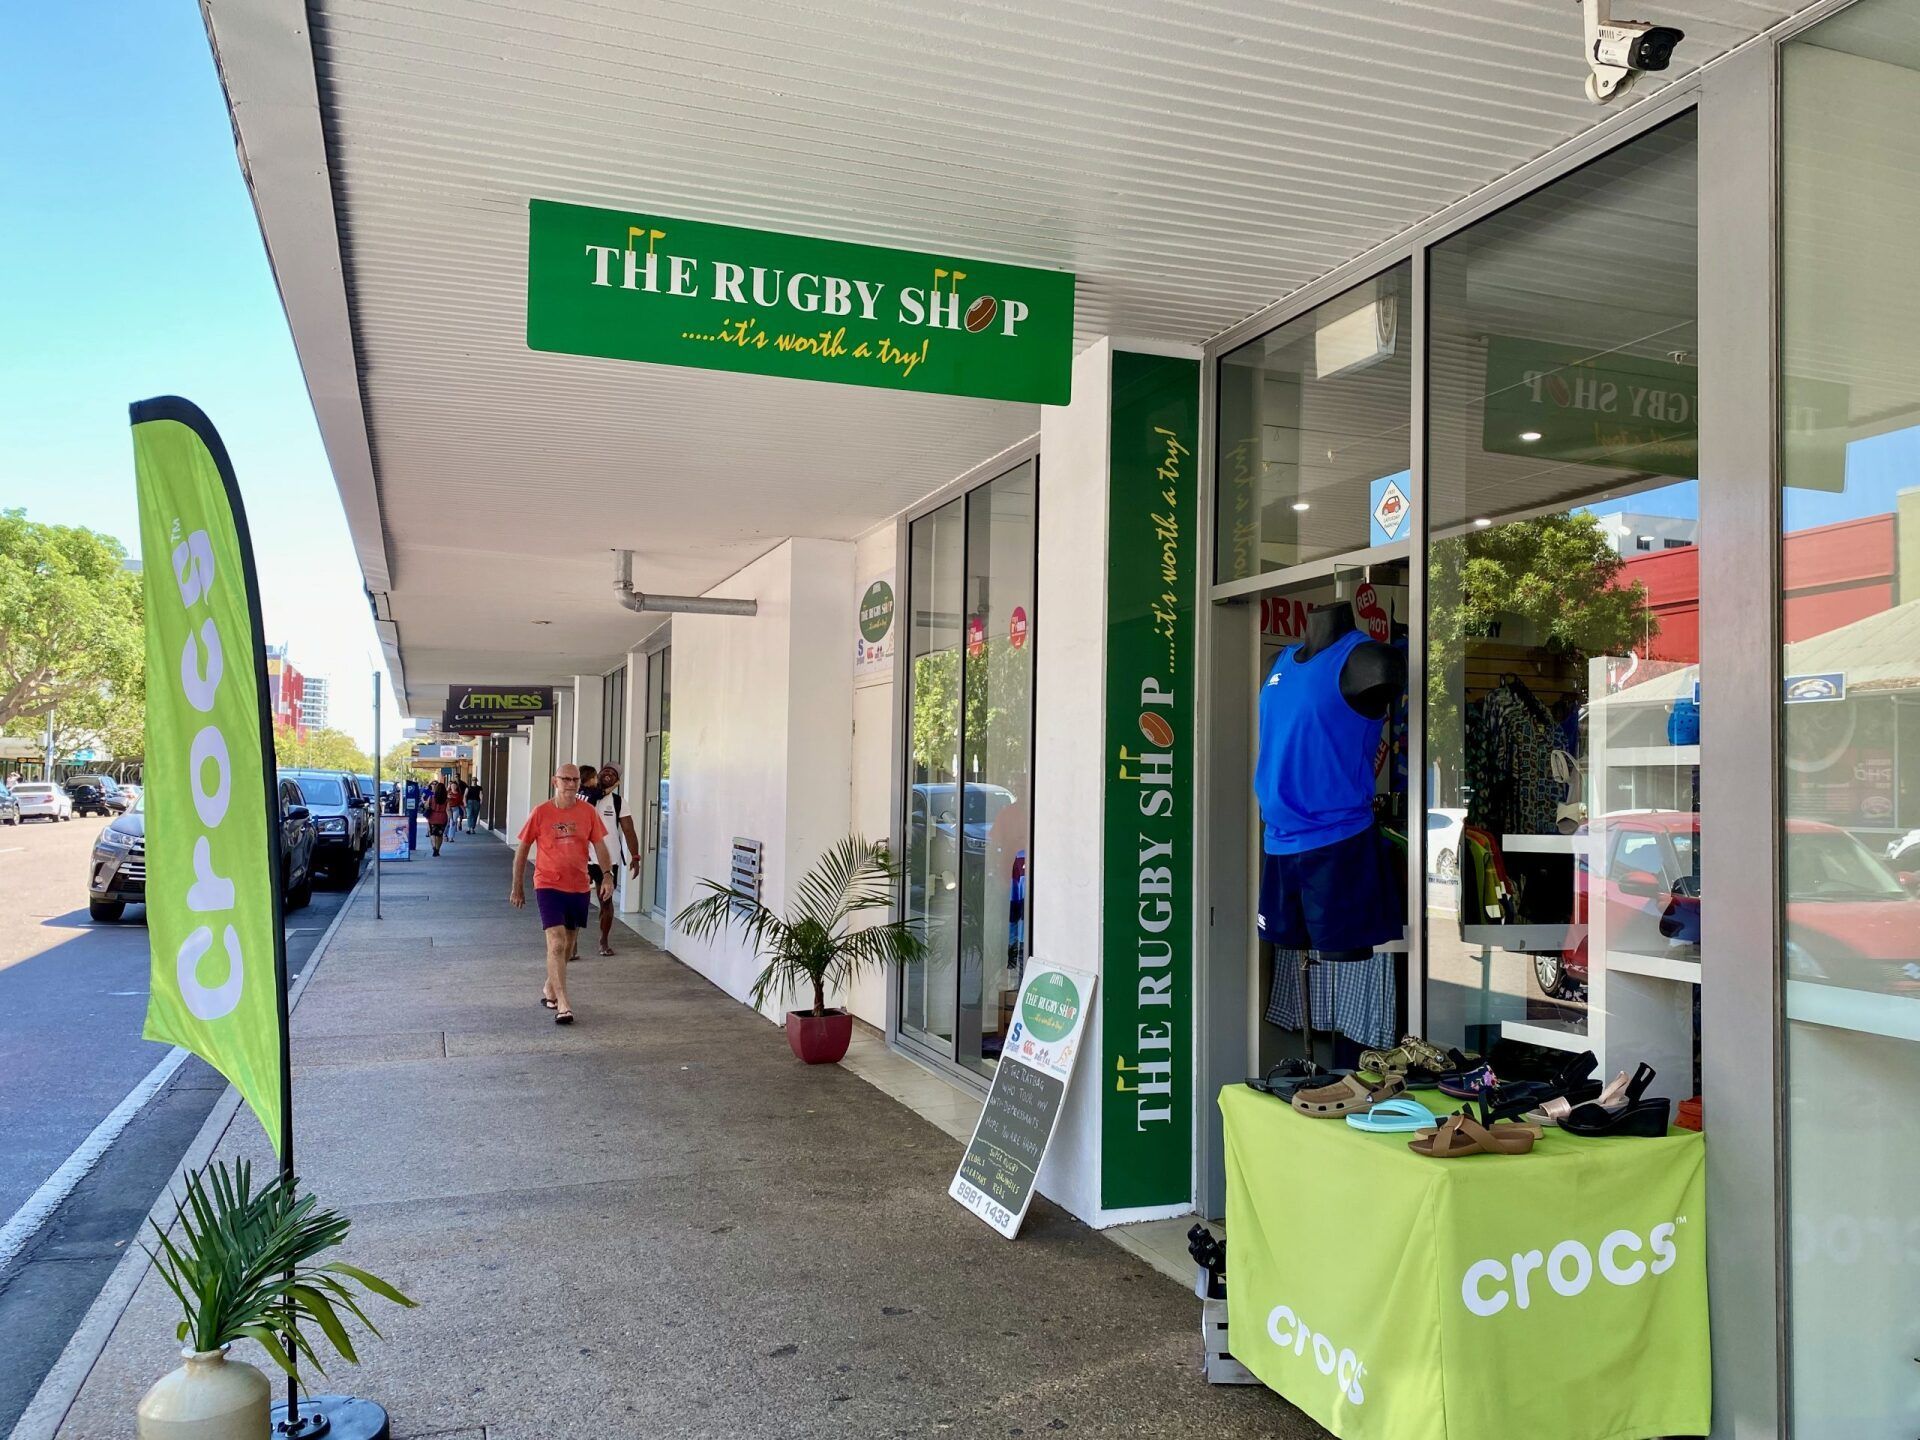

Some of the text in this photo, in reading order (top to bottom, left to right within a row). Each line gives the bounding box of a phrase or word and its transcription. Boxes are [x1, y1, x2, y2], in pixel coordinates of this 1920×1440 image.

[585, 241, 1030, 338] THE RUGBY SHOP
[773, 326, 848, 357] worth
[851, 341, 871, 360] a
[876, 337, 930, 378] try!
[1154, 425, 1191, 484] try!
[1163, 486, 1177, 504] a
[1149, 511, 1180, 589] worth
[1356, 588, 1376, 612] RED
[1370, 616, 1387, 635] HOT
[171, 527, 244, 1022] crocs
[1137, 676, 1176, 1132] THE RUGBY SHOP
[1025, 992, 1078, 1020] THE RUGBY SHOP
[1001, 1083, 1016, 1097] WHO
[1019, 1088, 1034, 1106] TOOK
[1010, 1064, 1021, 1080] THE
[956, 1181, 1011, 1228] 8981 1433
[1461, 1221, 1677, 1317] crocs
[1265, 1304, 1366, 1406] crocs
